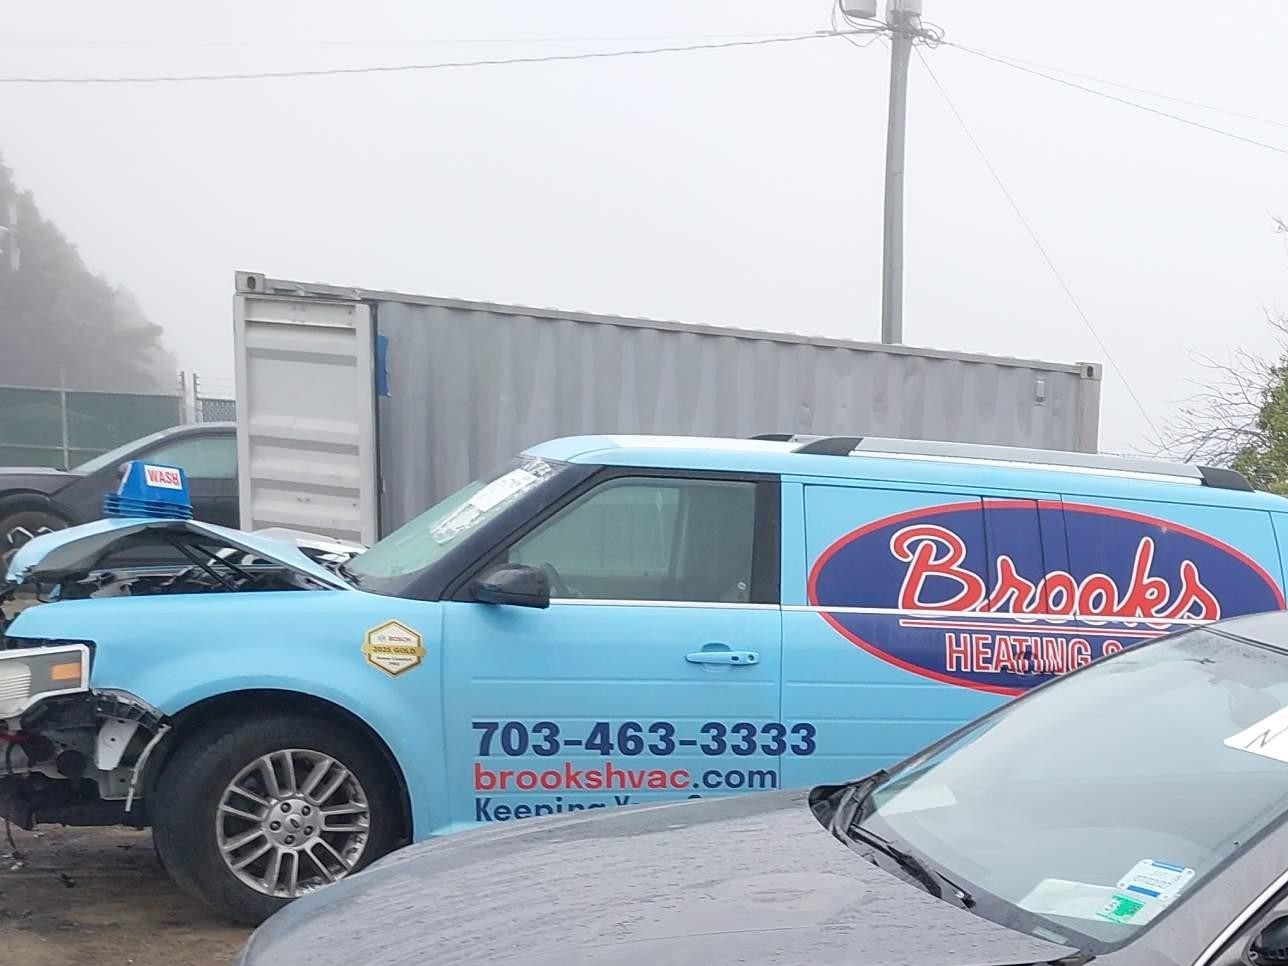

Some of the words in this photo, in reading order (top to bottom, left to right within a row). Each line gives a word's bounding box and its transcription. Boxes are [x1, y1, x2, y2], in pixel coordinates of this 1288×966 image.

[147, 469, 179, 486] WASH
[890, 524, 1221, 626] Brooks
[945, 632, 1091, 675] HEATING
[472, 721, 817, 757] 703-463-3333
[474, 762, 778, 790] brookshvac.com
